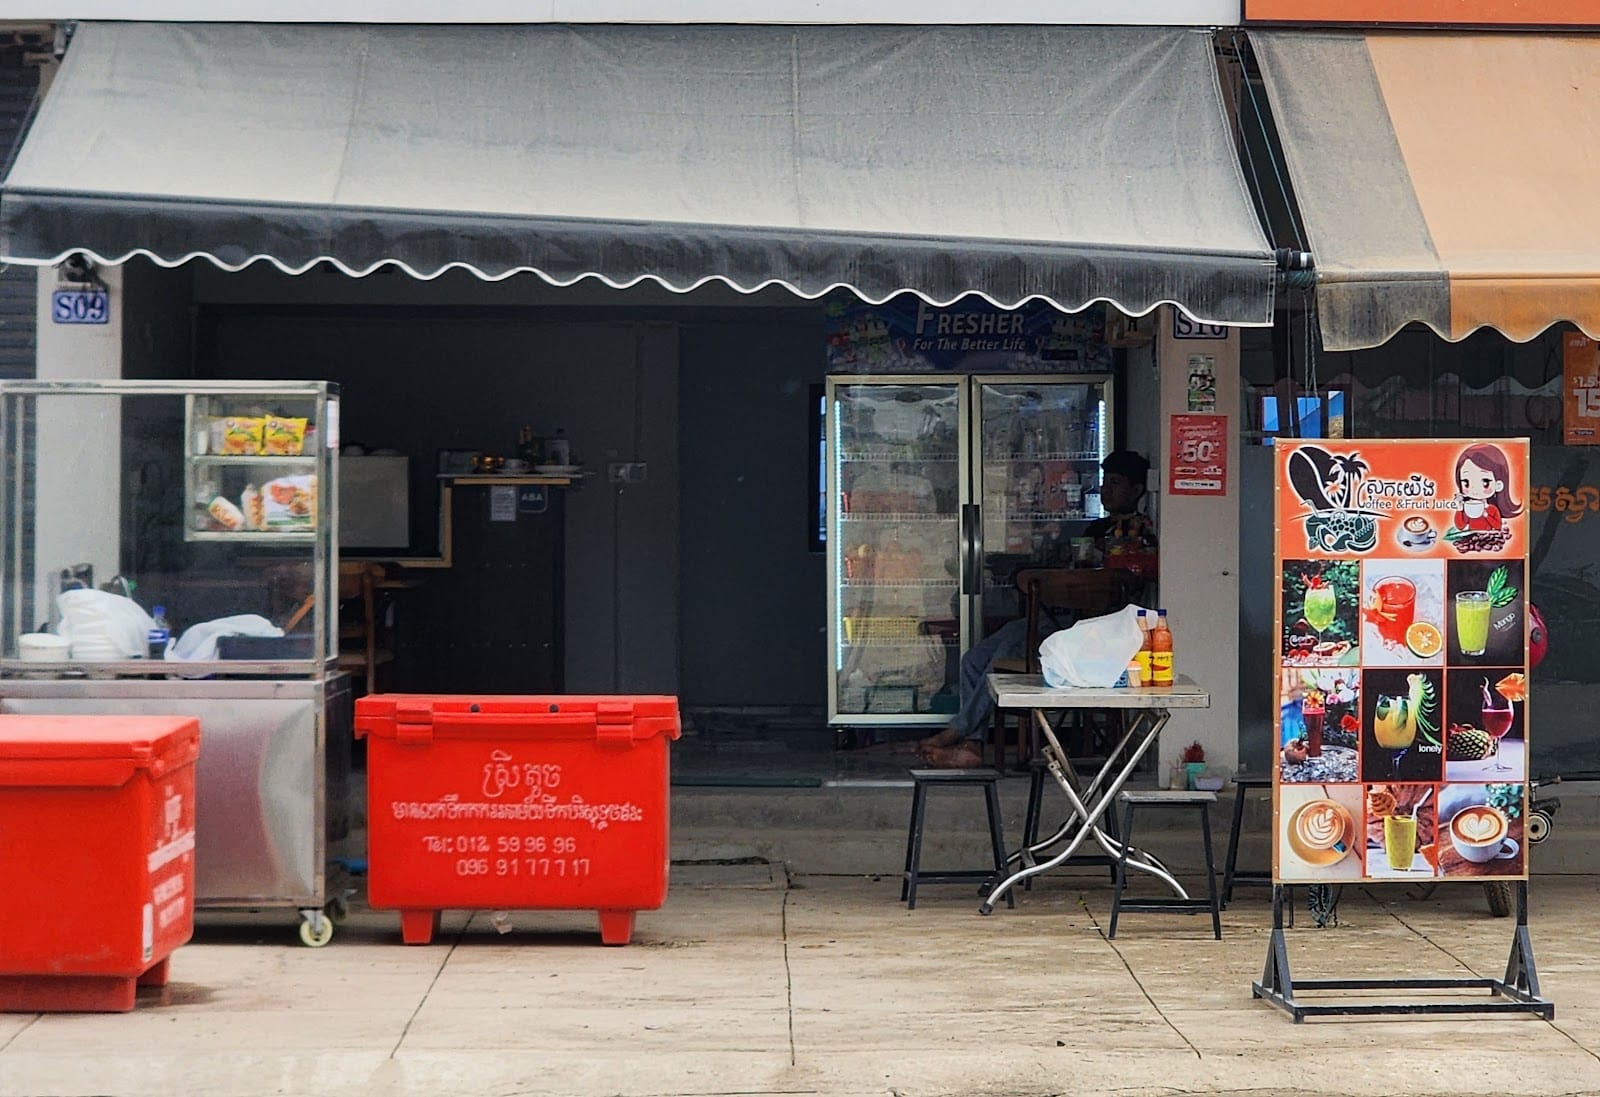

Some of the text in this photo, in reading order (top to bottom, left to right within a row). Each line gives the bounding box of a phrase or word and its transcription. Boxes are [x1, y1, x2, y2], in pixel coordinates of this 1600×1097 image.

[56, 294, 106, 320] S09
[915, 305, 1025, 335] FRESHER
[913, 339, 1025, 352] For The Better Life
[1432, 498, 1457, 509] Juice
[1418, 744, 1442, 754] lonely
[456, 836, 490, 853] 012
[497, 837, 521, 853] 59
[525, 837, 547, 853] 96
[553, 837, 577, 854] 96
[456, 858, 489, 876] 096
[496, 858, 519, 876] 91
